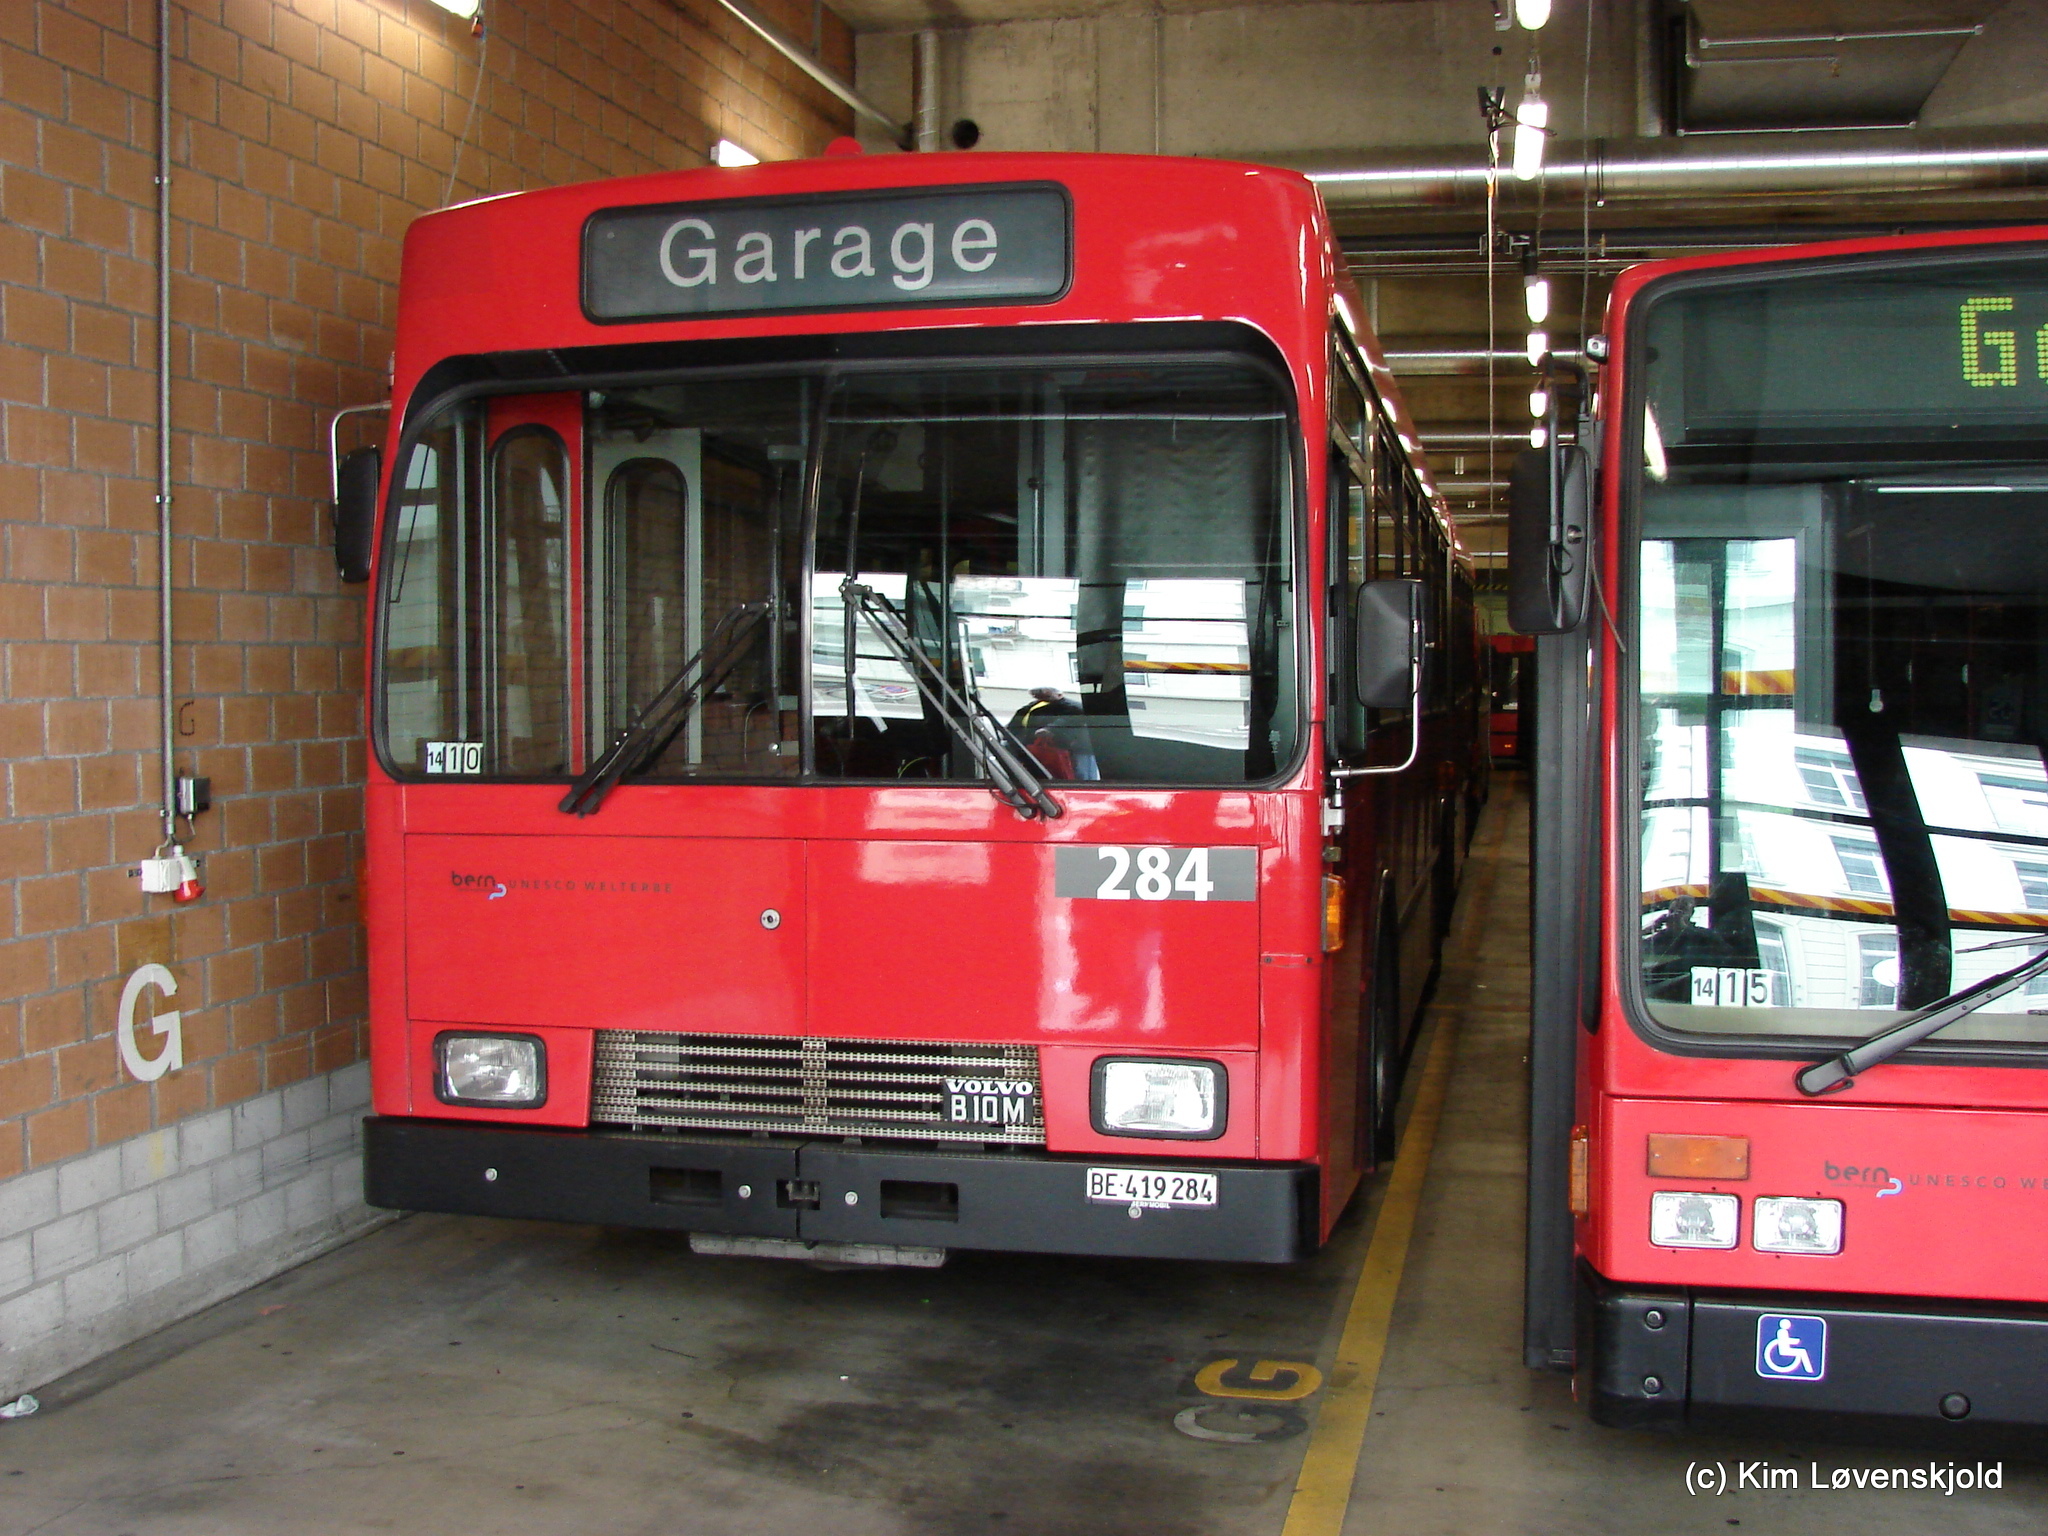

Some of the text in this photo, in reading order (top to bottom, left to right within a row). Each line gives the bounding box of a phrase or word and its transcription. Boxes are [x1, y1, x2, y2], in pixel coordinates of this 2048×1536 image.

[658, 216, 999, 291] Garage
[1960, 297, 2048, 387] G
[428, 750, 444, 767] 14
[451, 870, 673, 894] bern UNESCO WELTERBE
[1096, 846, 1215, 902] 284
[1693, 977, 1714, 998] 14
[117, 963, 184, 1083] G
[946, 1078, 1034, 1096] VOLVO
[950, 1094, 1025, 1123] B10M
[1824, 1160, 1890, 1183] bern
[1908, 1174, 2006, 1189] UNESCO
[1194, 1358, 1323, 1400] G
